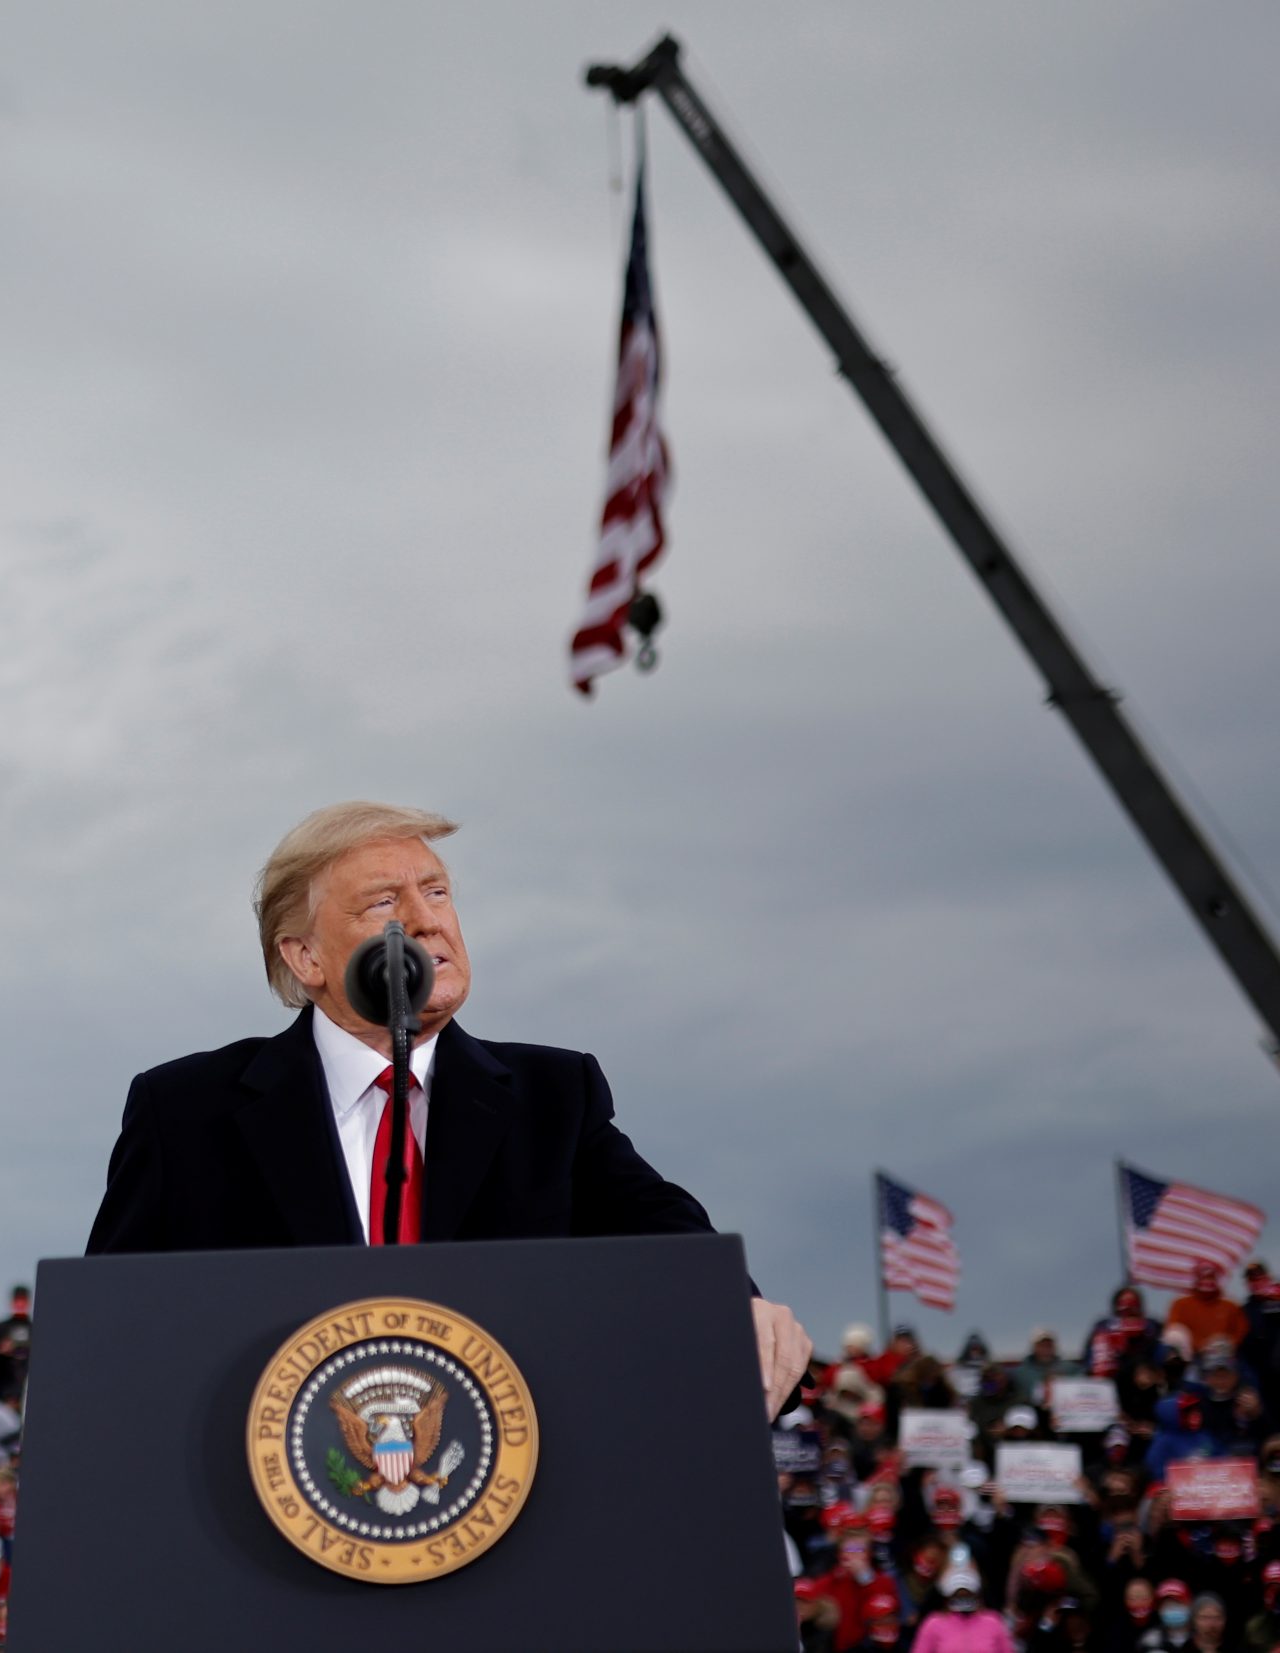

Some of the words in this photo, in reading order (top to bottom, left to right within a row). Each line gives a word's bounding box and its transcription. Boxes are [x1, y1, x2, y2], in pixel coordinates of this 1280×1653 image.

[384, 1312, 410, 1329] OF
[416, 1316, 453, 1342] THE
[259, 1312, 375, 1440] PRESIDENT
[460, 1335, 528, 1446] UNITED
[264, 1453, 286, 1491] THE
[278, 1495, 300, 1519] OF
[427, 1474, 520, 1566] STATES
[302, 1515, 375, 1570] SEAL
